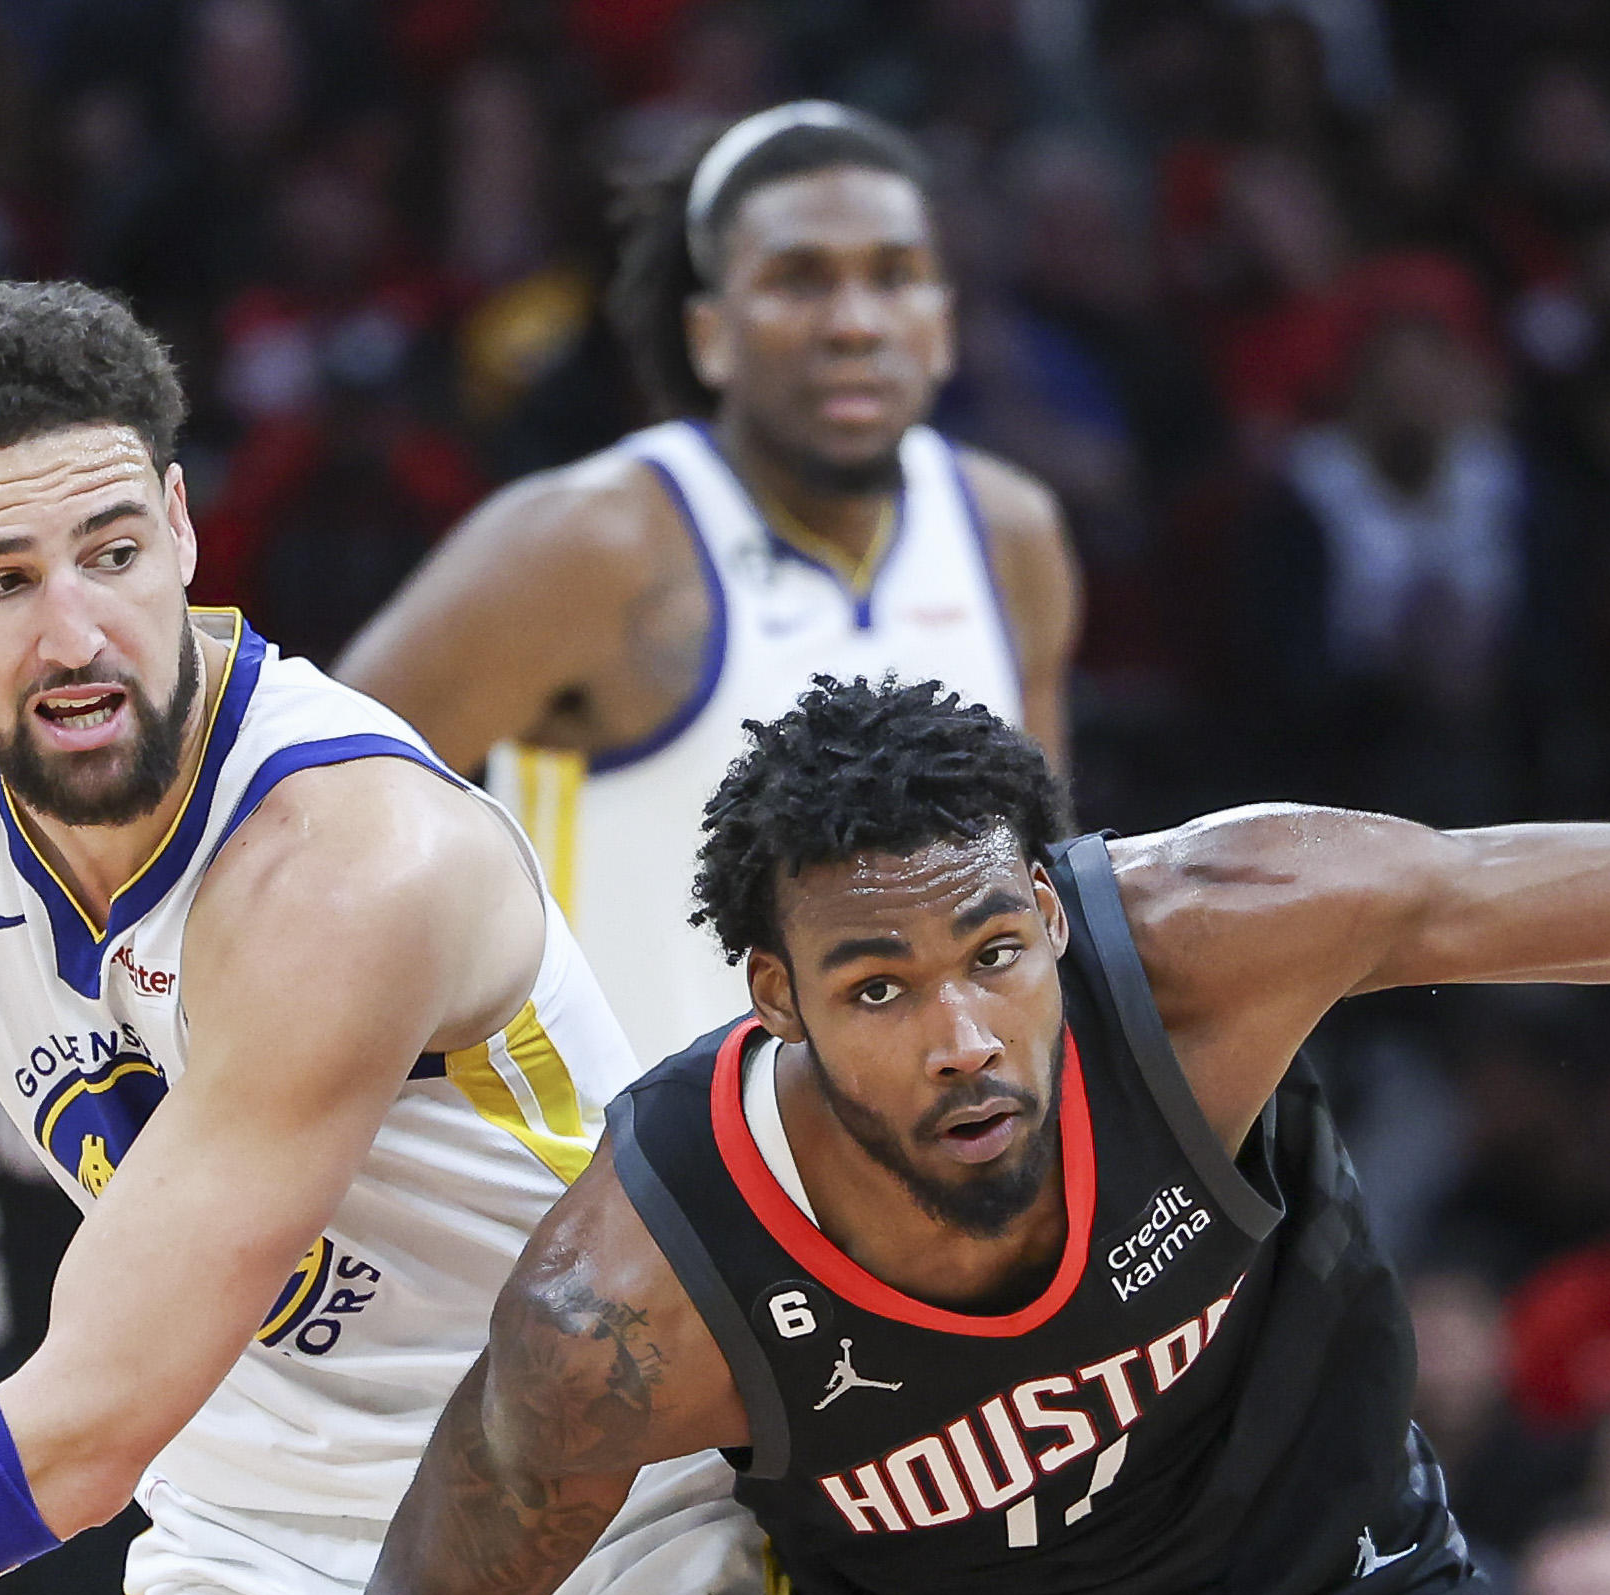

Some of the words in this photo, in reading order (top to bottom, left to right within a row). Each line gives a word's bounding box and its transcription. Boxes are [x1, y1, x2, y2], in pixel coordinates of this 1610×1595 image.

[1108, 1185, 1193, 1269] credit
[1111, 1208, 1211, 1302] karma
[769, 1290, 816, 1339] 6
